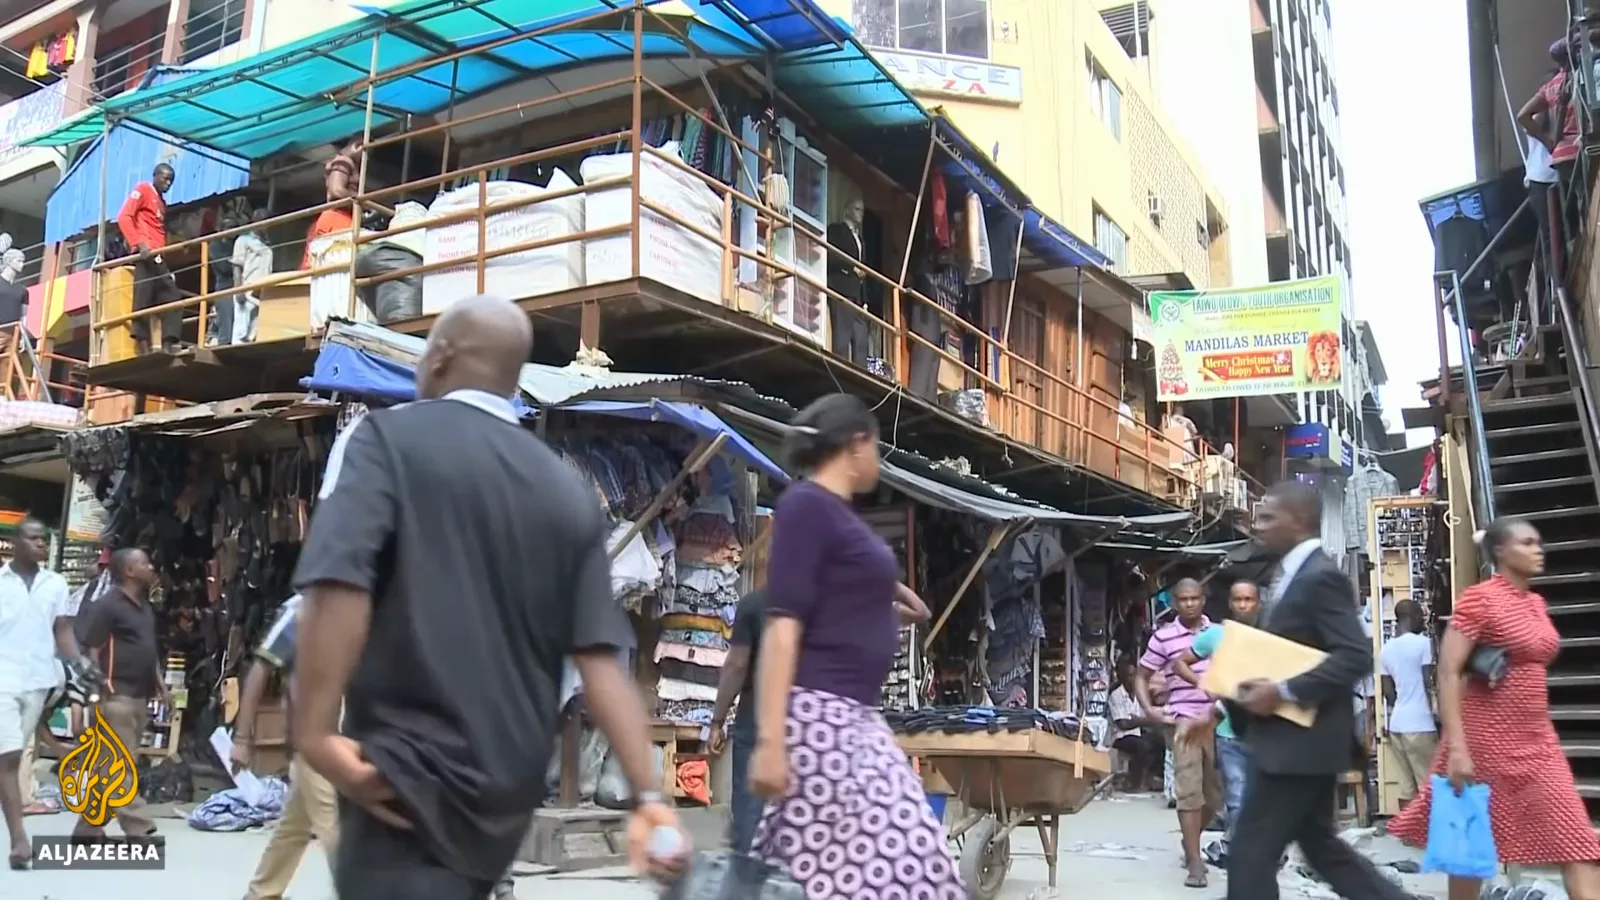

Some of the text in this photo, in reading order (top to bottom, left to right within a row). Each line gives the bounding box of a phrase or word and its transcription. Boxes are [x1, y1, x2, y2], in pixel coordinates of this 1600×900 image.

[1247, 290, 1274, 309] YOUTH
[1273, 285, 1333, 306] ORGANISATION
[1185, 331, 1309, 352] MANDILAS MARKET
[1205, 355, 1275, 369] Merry Christmas
[1228, 363, 1290, 377] Happy New Year
